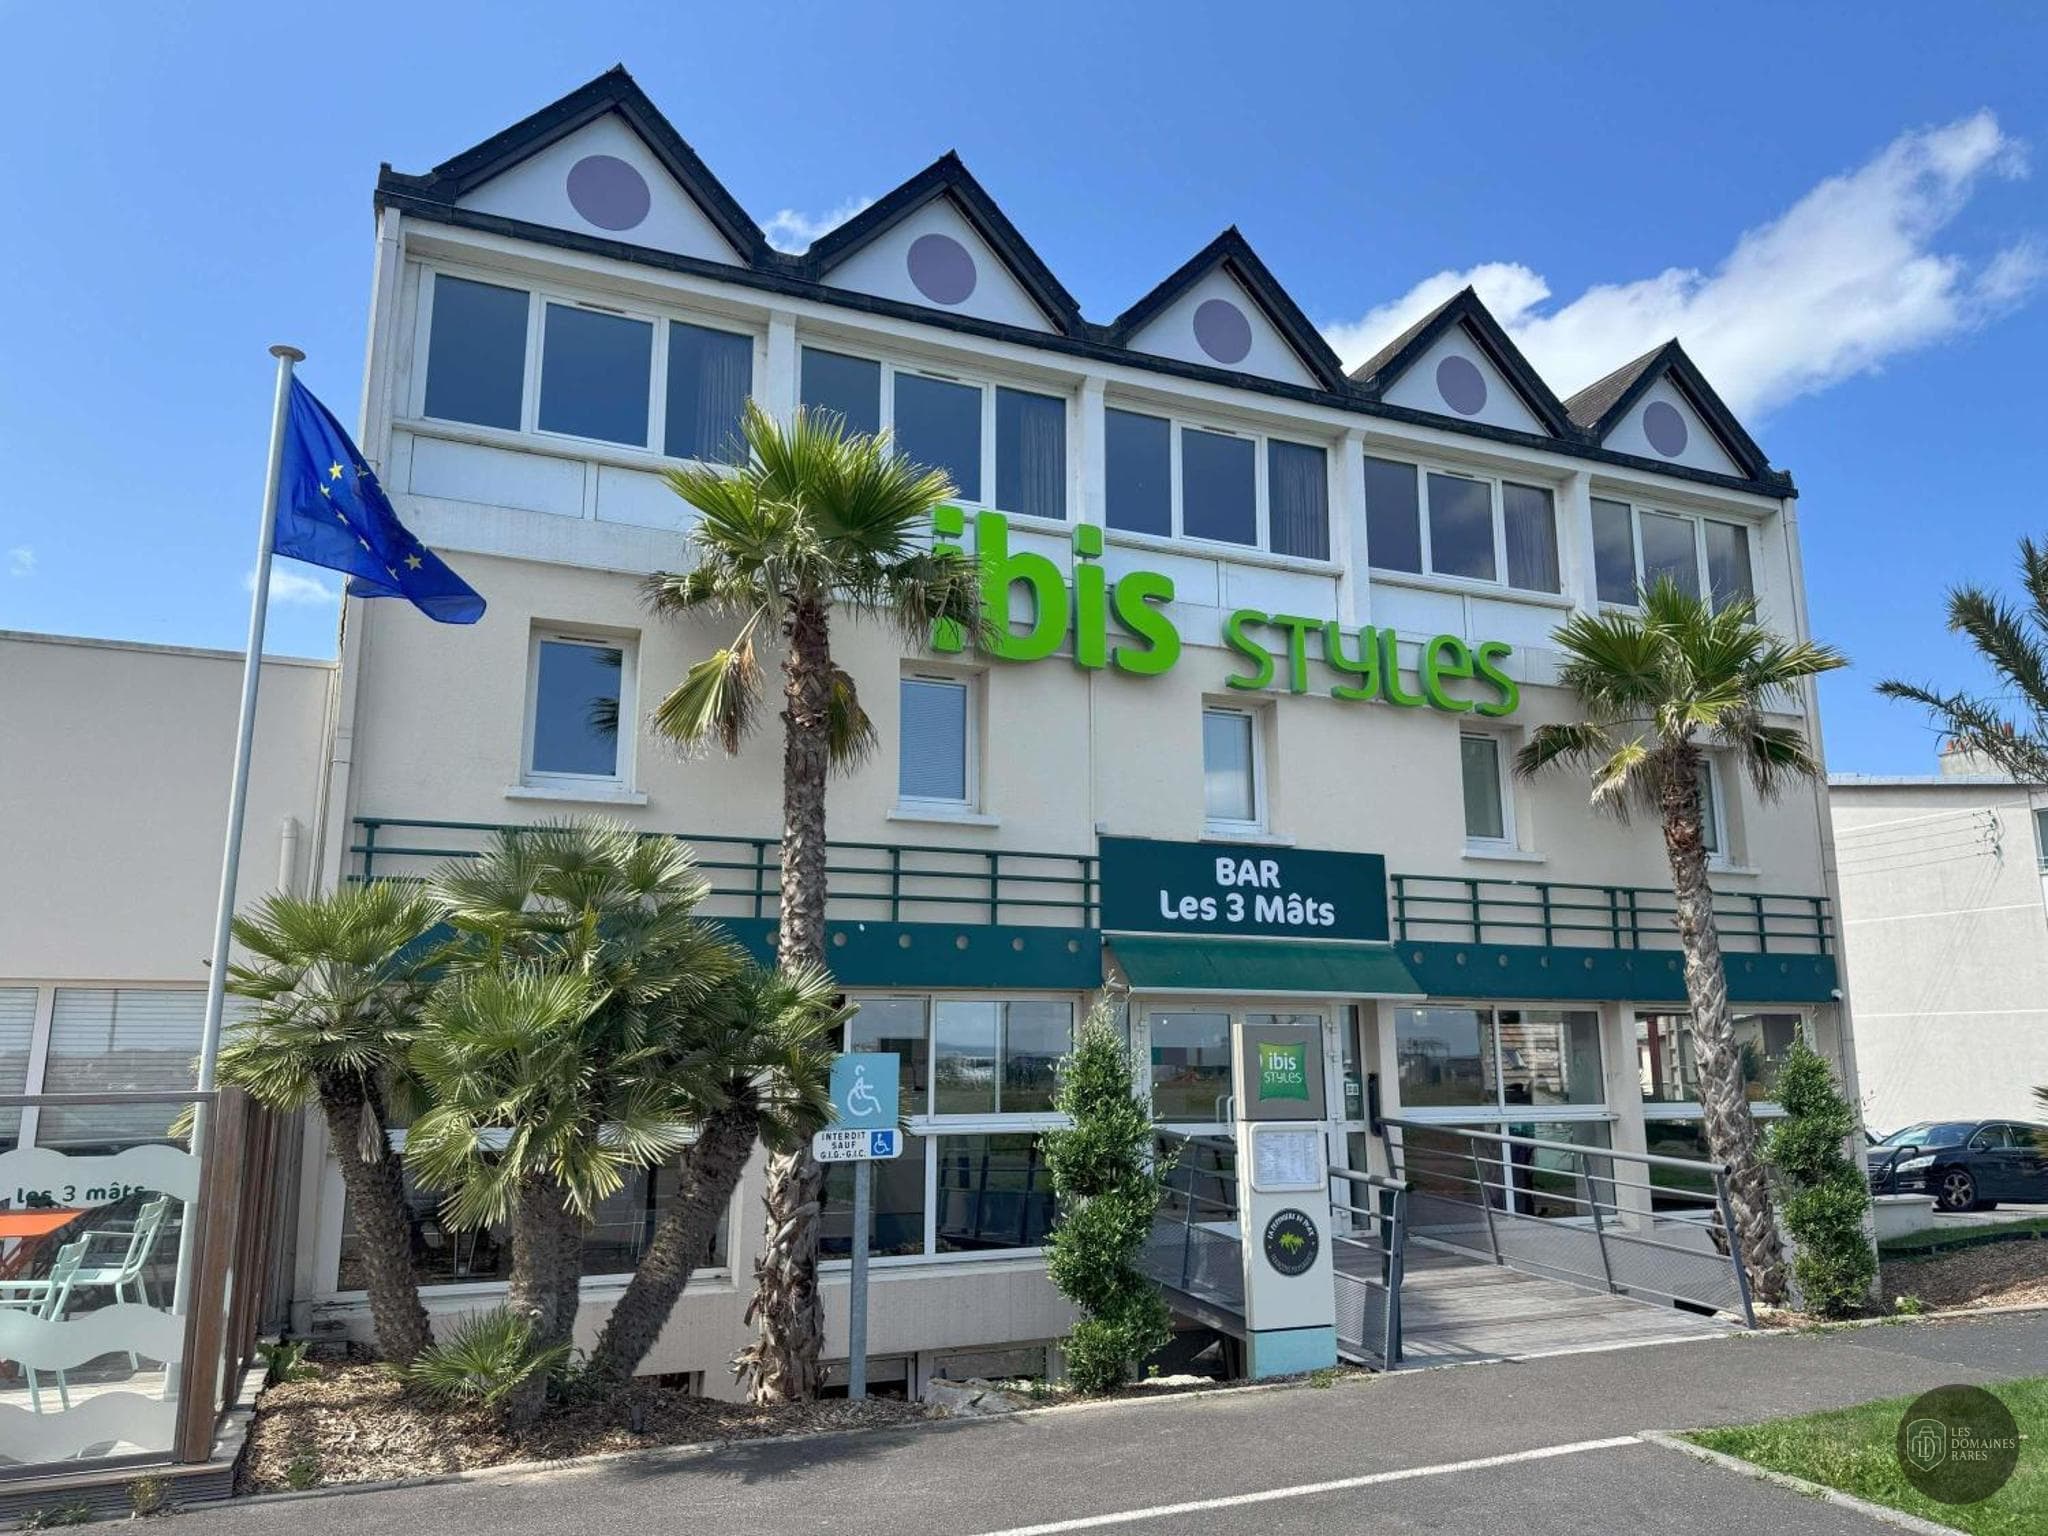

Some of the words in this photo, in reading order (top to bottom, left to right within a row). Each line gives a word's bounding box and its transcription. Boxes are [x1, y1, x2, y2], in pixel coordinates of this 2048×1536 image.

[931, 504, 1181, 676] ibis
[1215, 856, 1282, 889] BAR
[1159, 889, 1218, 922] Les
[1225, 892, 1245, 923] 3
[1254, 892, 1336, 926] Mâts
[1268, 1052, 1297, 1071] ibis
[821, 1131, 866, 1141] INTERDIT
[831, 1141, 857, 1150] SAUF
[62, 1185, 76, 1202] 3
